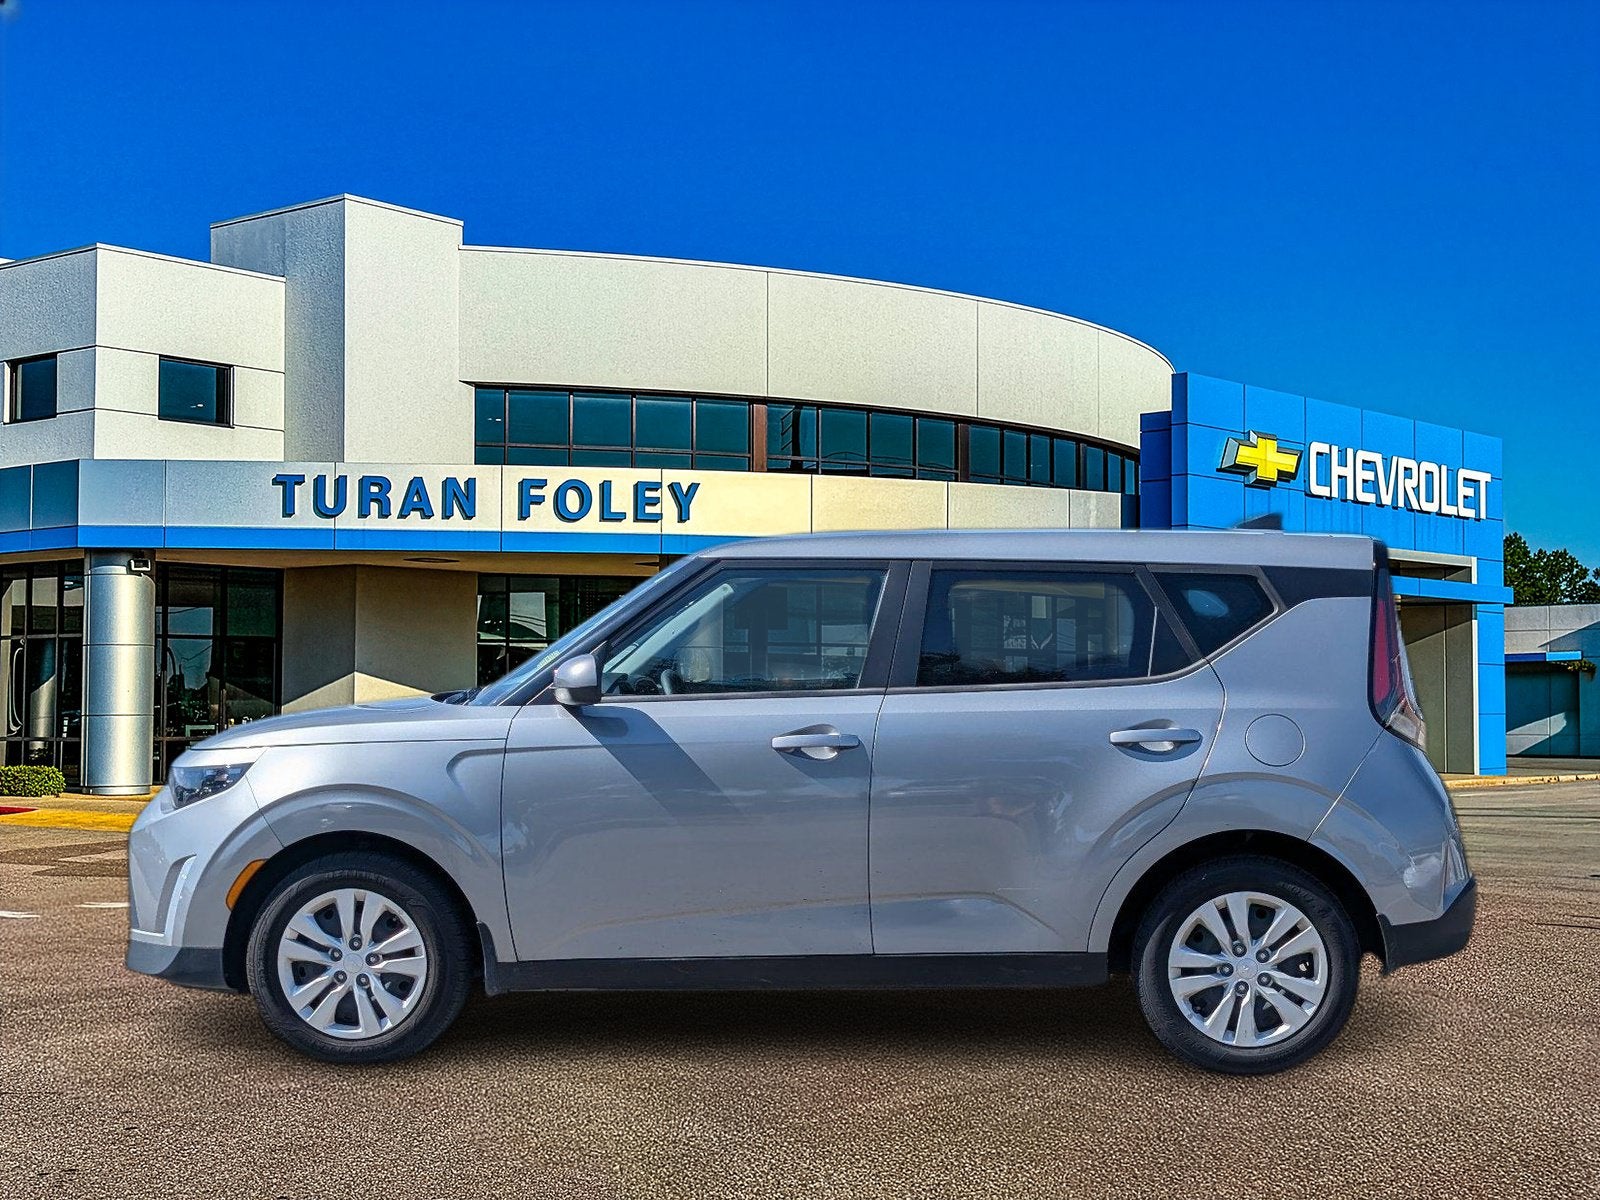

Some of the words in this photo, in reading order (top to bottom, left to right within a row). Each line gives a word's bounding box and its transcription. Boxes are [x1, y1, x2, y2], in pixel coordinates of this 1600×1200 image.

[271, 473, 477, 520] TURAN
[517, 477, 701, 523] FOLEY
[1308, 441, 1492, 519] CHEVROLET
